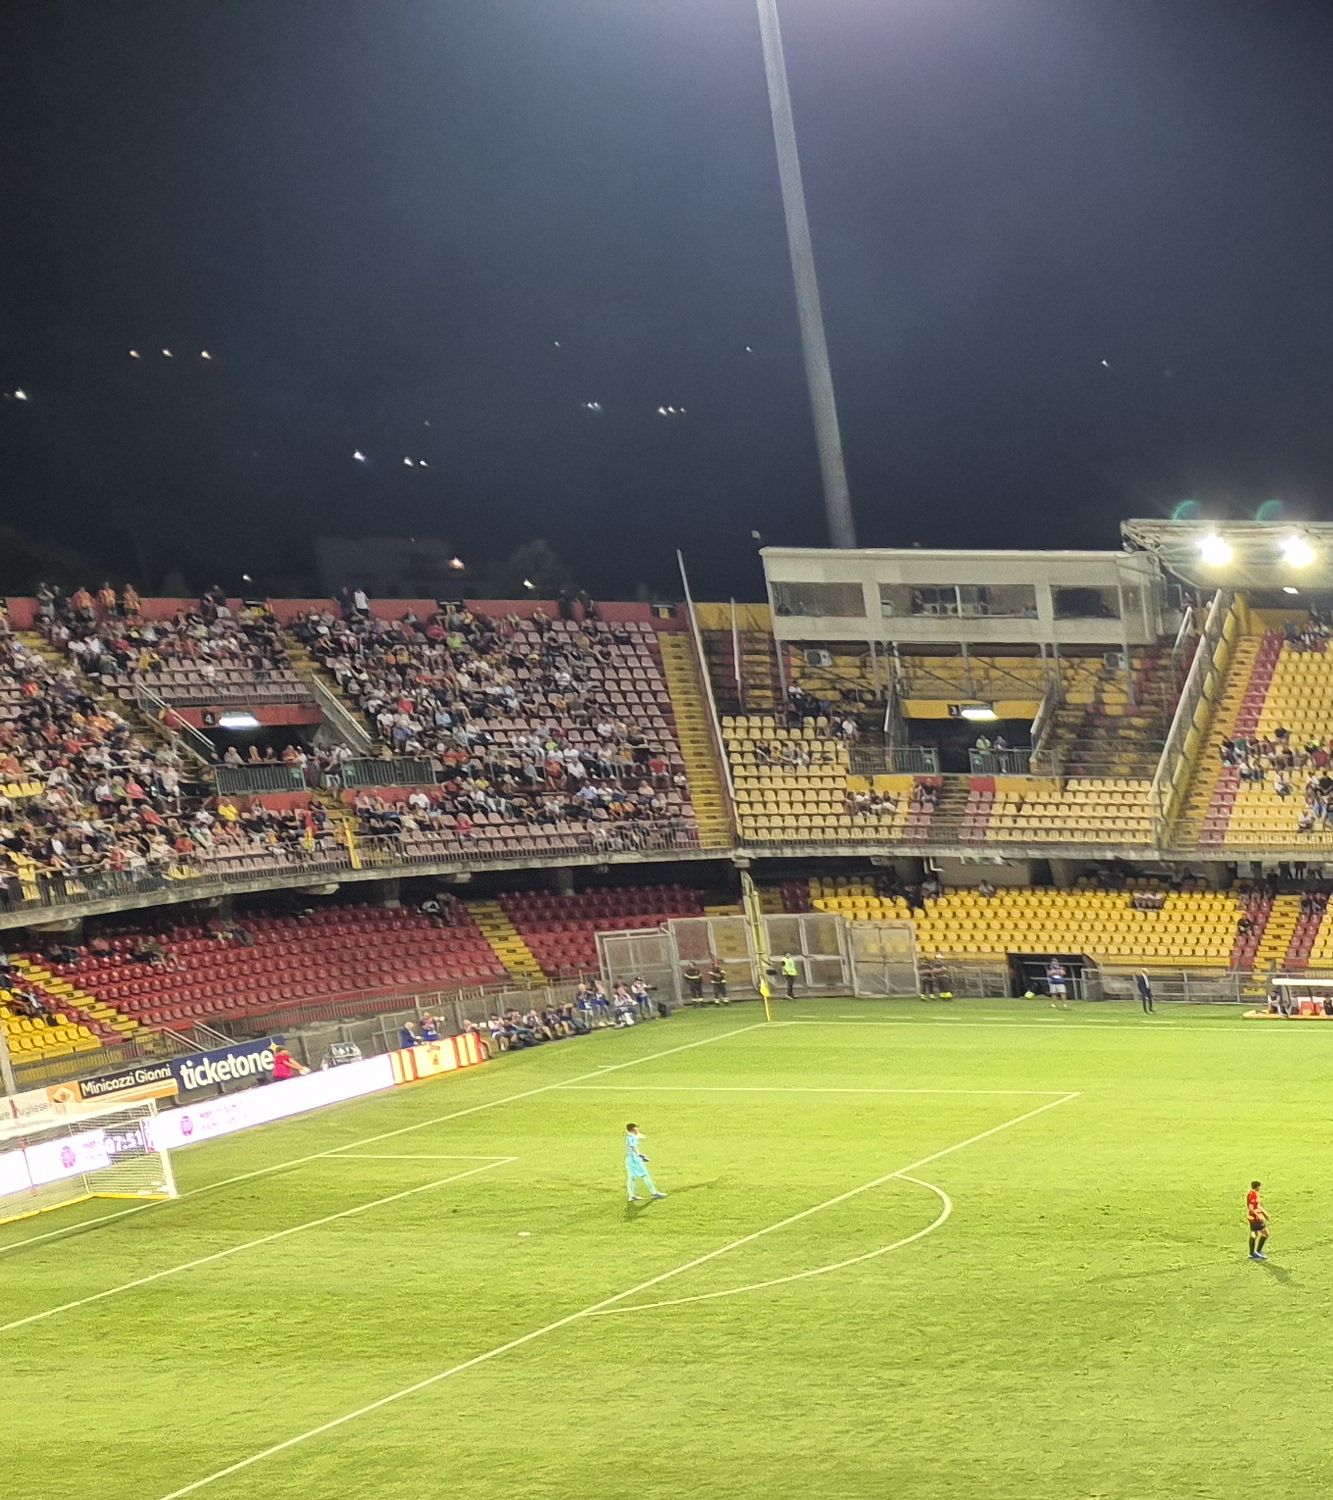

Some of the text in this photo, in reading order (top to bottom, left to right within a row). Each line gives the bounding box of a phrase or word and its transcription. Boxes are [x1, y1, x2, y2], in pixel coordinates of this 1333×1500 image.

[205, 713, 213, 723] 4
[81, 1069, 135, 1098] Minicozzi
[134, 1063, 173, 1085] Gianni
[178, 1048, 275, 1091] ticketone
